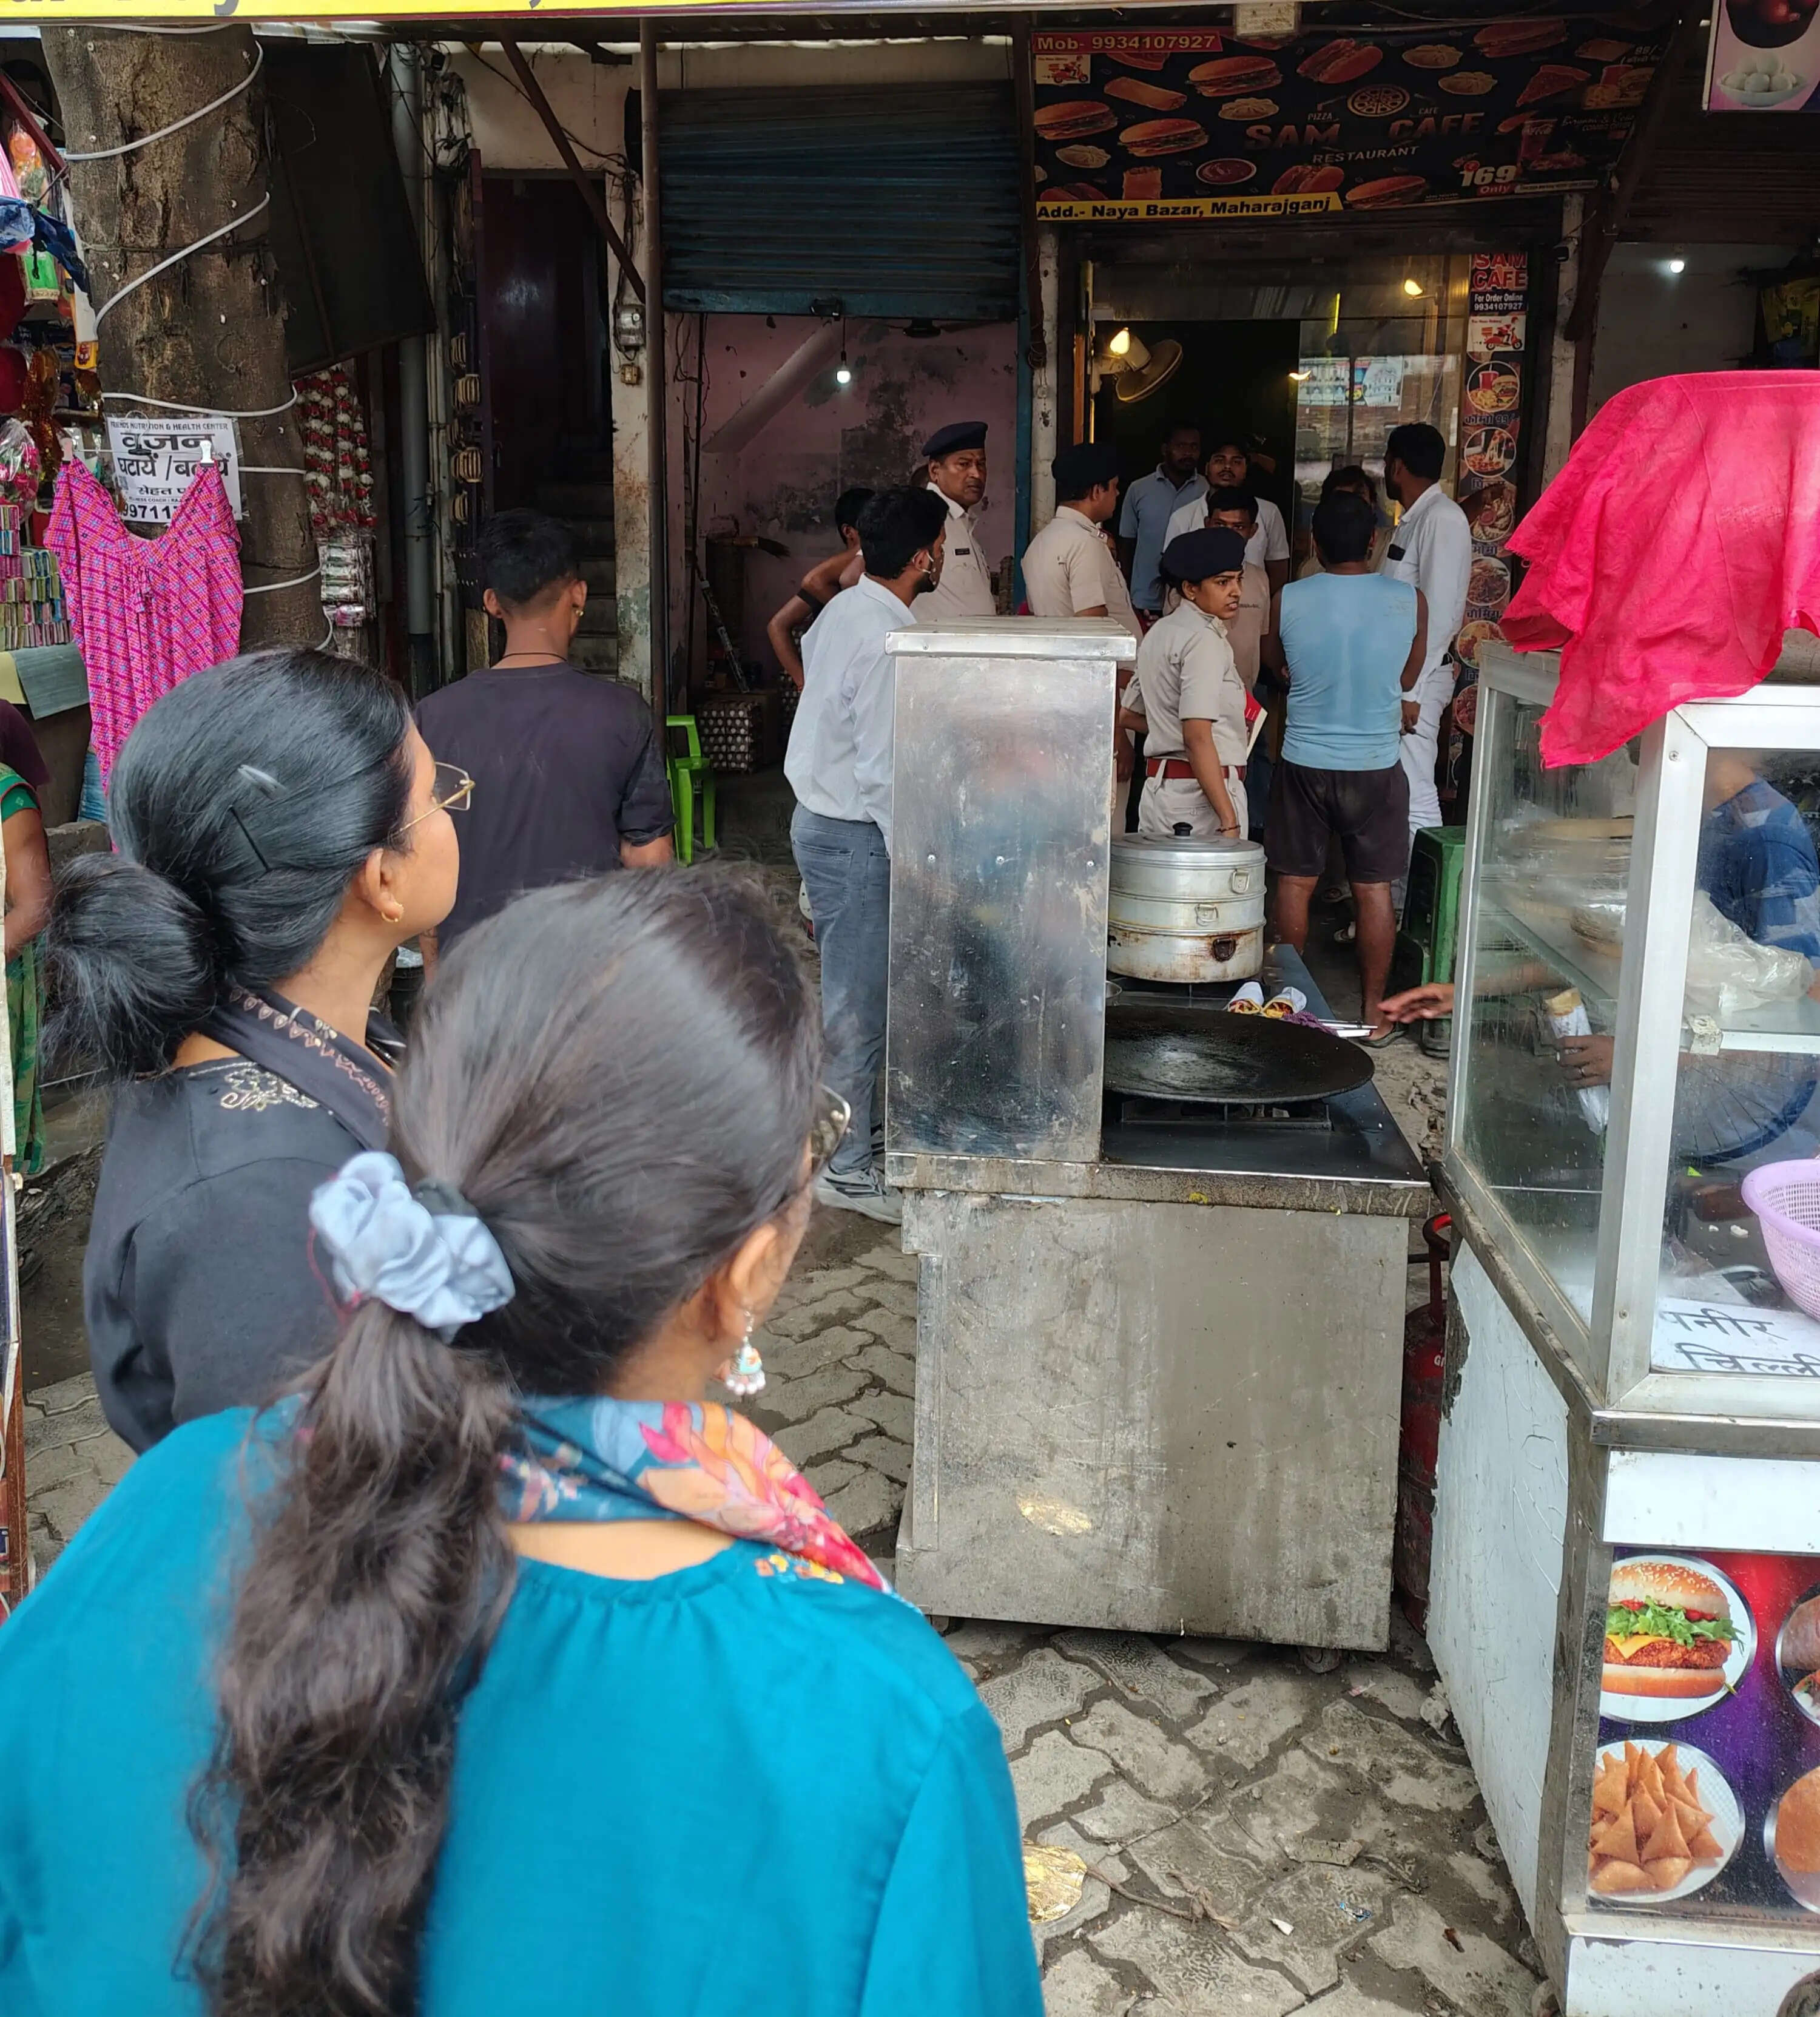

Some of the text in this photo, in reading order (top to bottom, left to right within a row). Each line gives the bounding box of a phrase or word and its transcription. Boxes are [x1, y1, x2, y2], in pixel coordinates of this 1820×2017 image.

[1037, 35, 1216, 50] Mob- 9934107927
[1307, 112, 1333, 121] PIZZA
[1418, 107, 1440, 115] CAFE
[1245, 112, 1485, 150] SAM CAFE
[1311, 145, 1420, 163] RESTAURANT
[1459, 164, 1517, 186] 169
[1480, 184, 1511, 195] Only
[1091, 204, 1140, 220] Naya
[1146, 202, 1204, 219] Bazar,
[1210, 197, 1331, 216] Maharajganj
[1474, 252, 1528, 269] SAM
[1474, 270, 1528, 290] CAFE
[1474, 292, 1524, 302] For Order Online
[1474, 302, 1523, 311] 9934107927
[117, 452, 159, 477] घटायें
[138, 485, 172, 496] सेहत
[1658, 1307, 1789, 1342] पनीर
